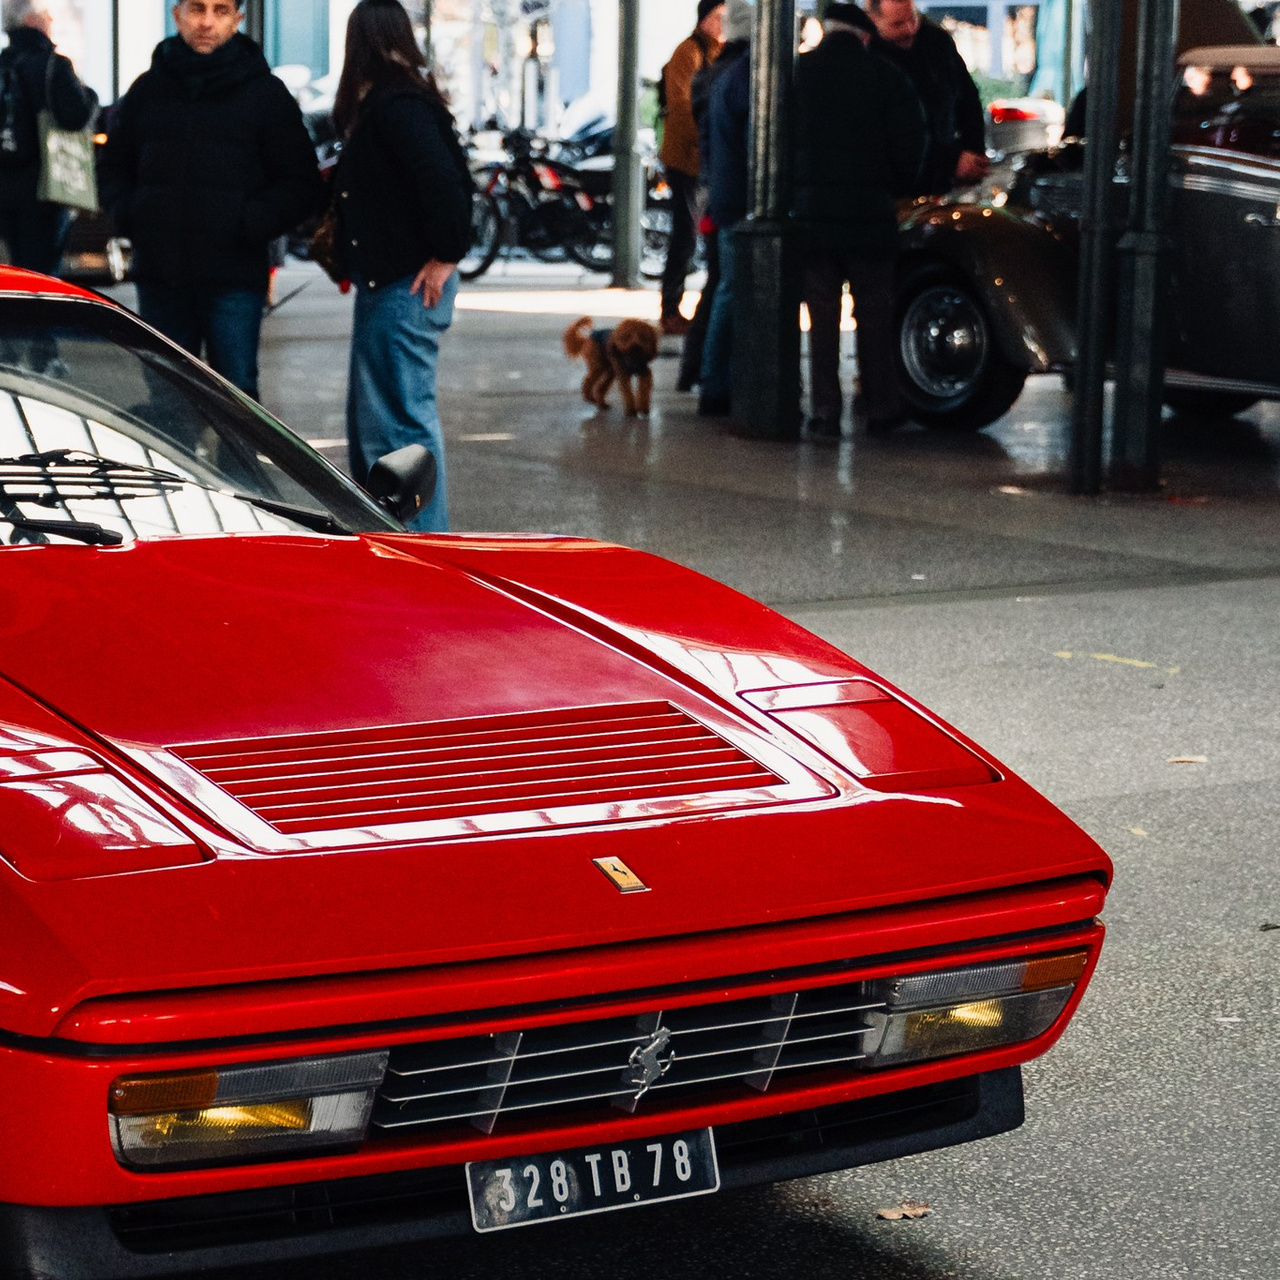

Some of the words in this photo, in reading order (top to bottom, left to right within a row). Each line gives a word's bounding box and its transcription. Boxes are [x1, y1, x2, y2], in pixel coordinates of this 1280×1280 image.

[495, 1159, 570, 1212] 328
[585, 1149, 631, 1197] TB
[646, 1139, 692, 1187] 78
